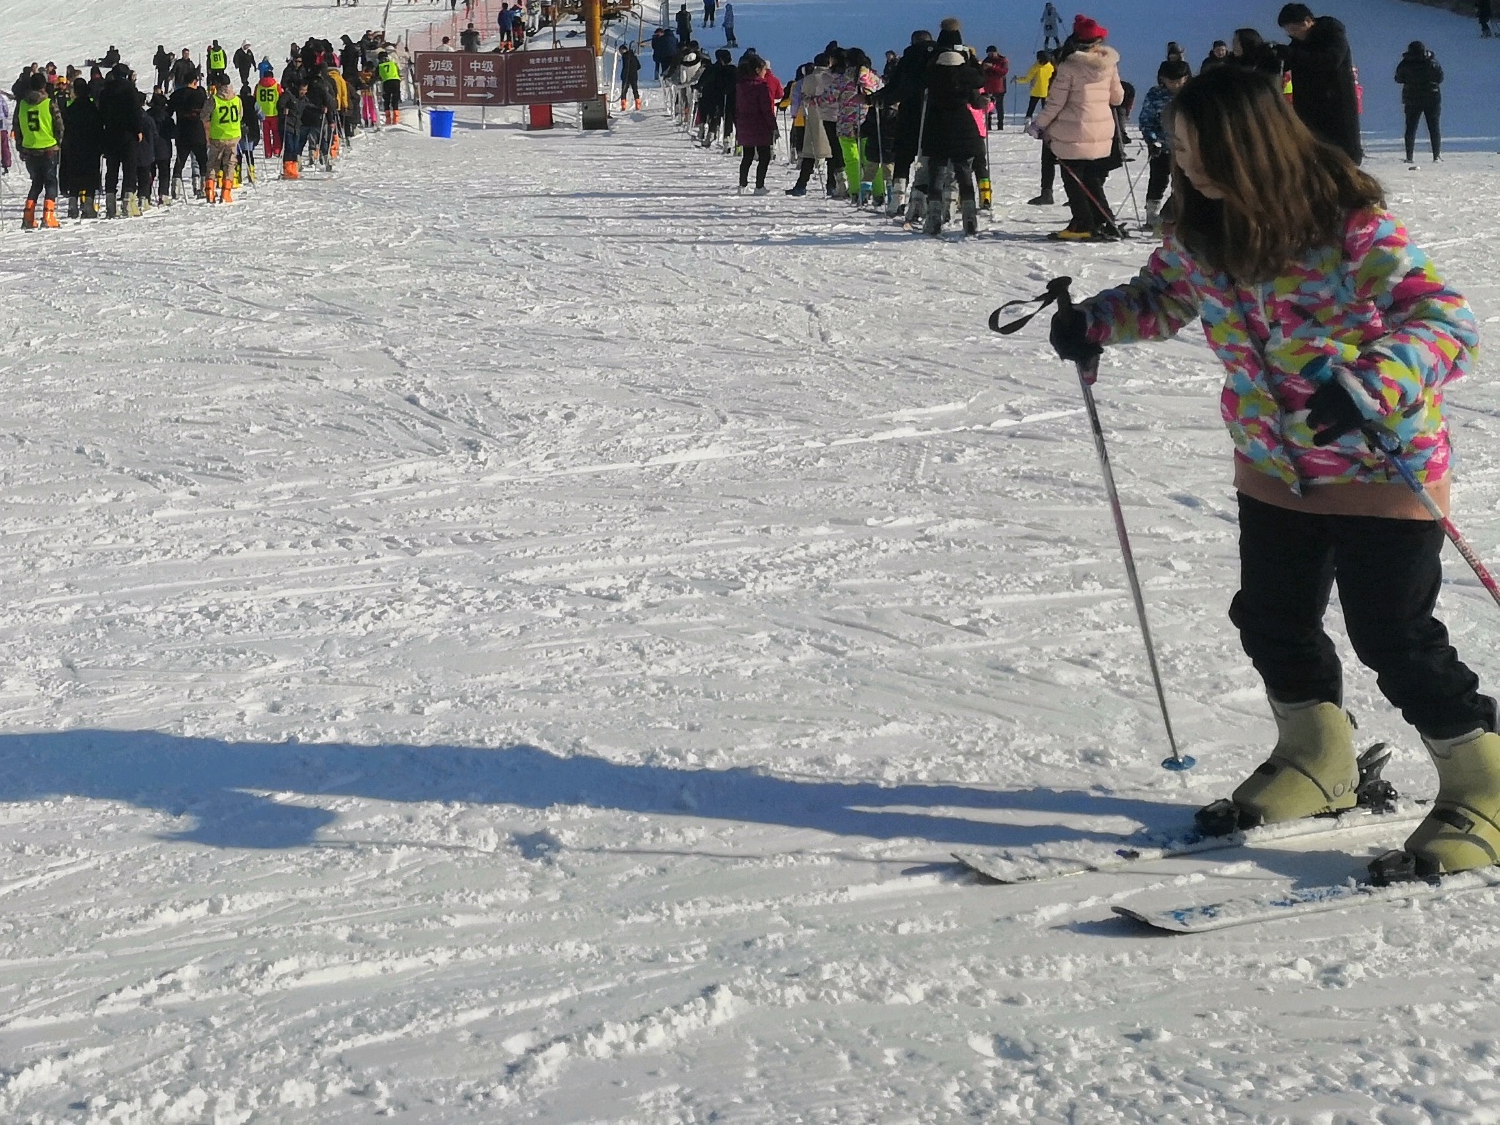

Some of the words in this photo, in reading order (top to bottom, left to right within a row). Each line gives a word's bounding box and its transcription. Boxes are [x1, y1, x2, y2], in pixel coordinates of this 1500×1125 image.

[383, 65, 390, 73] 7
[428, 59, 453, 72] 初级
[469, 59, 494, 73] 中级
[422, 74, 457, 87] 滑雪道
[463, 75, 498, 88] 滑雪道
[260, 89, 275, 102] 85
[27, 110, 40, 132] 5
[218, 105, 239, 124] 20
